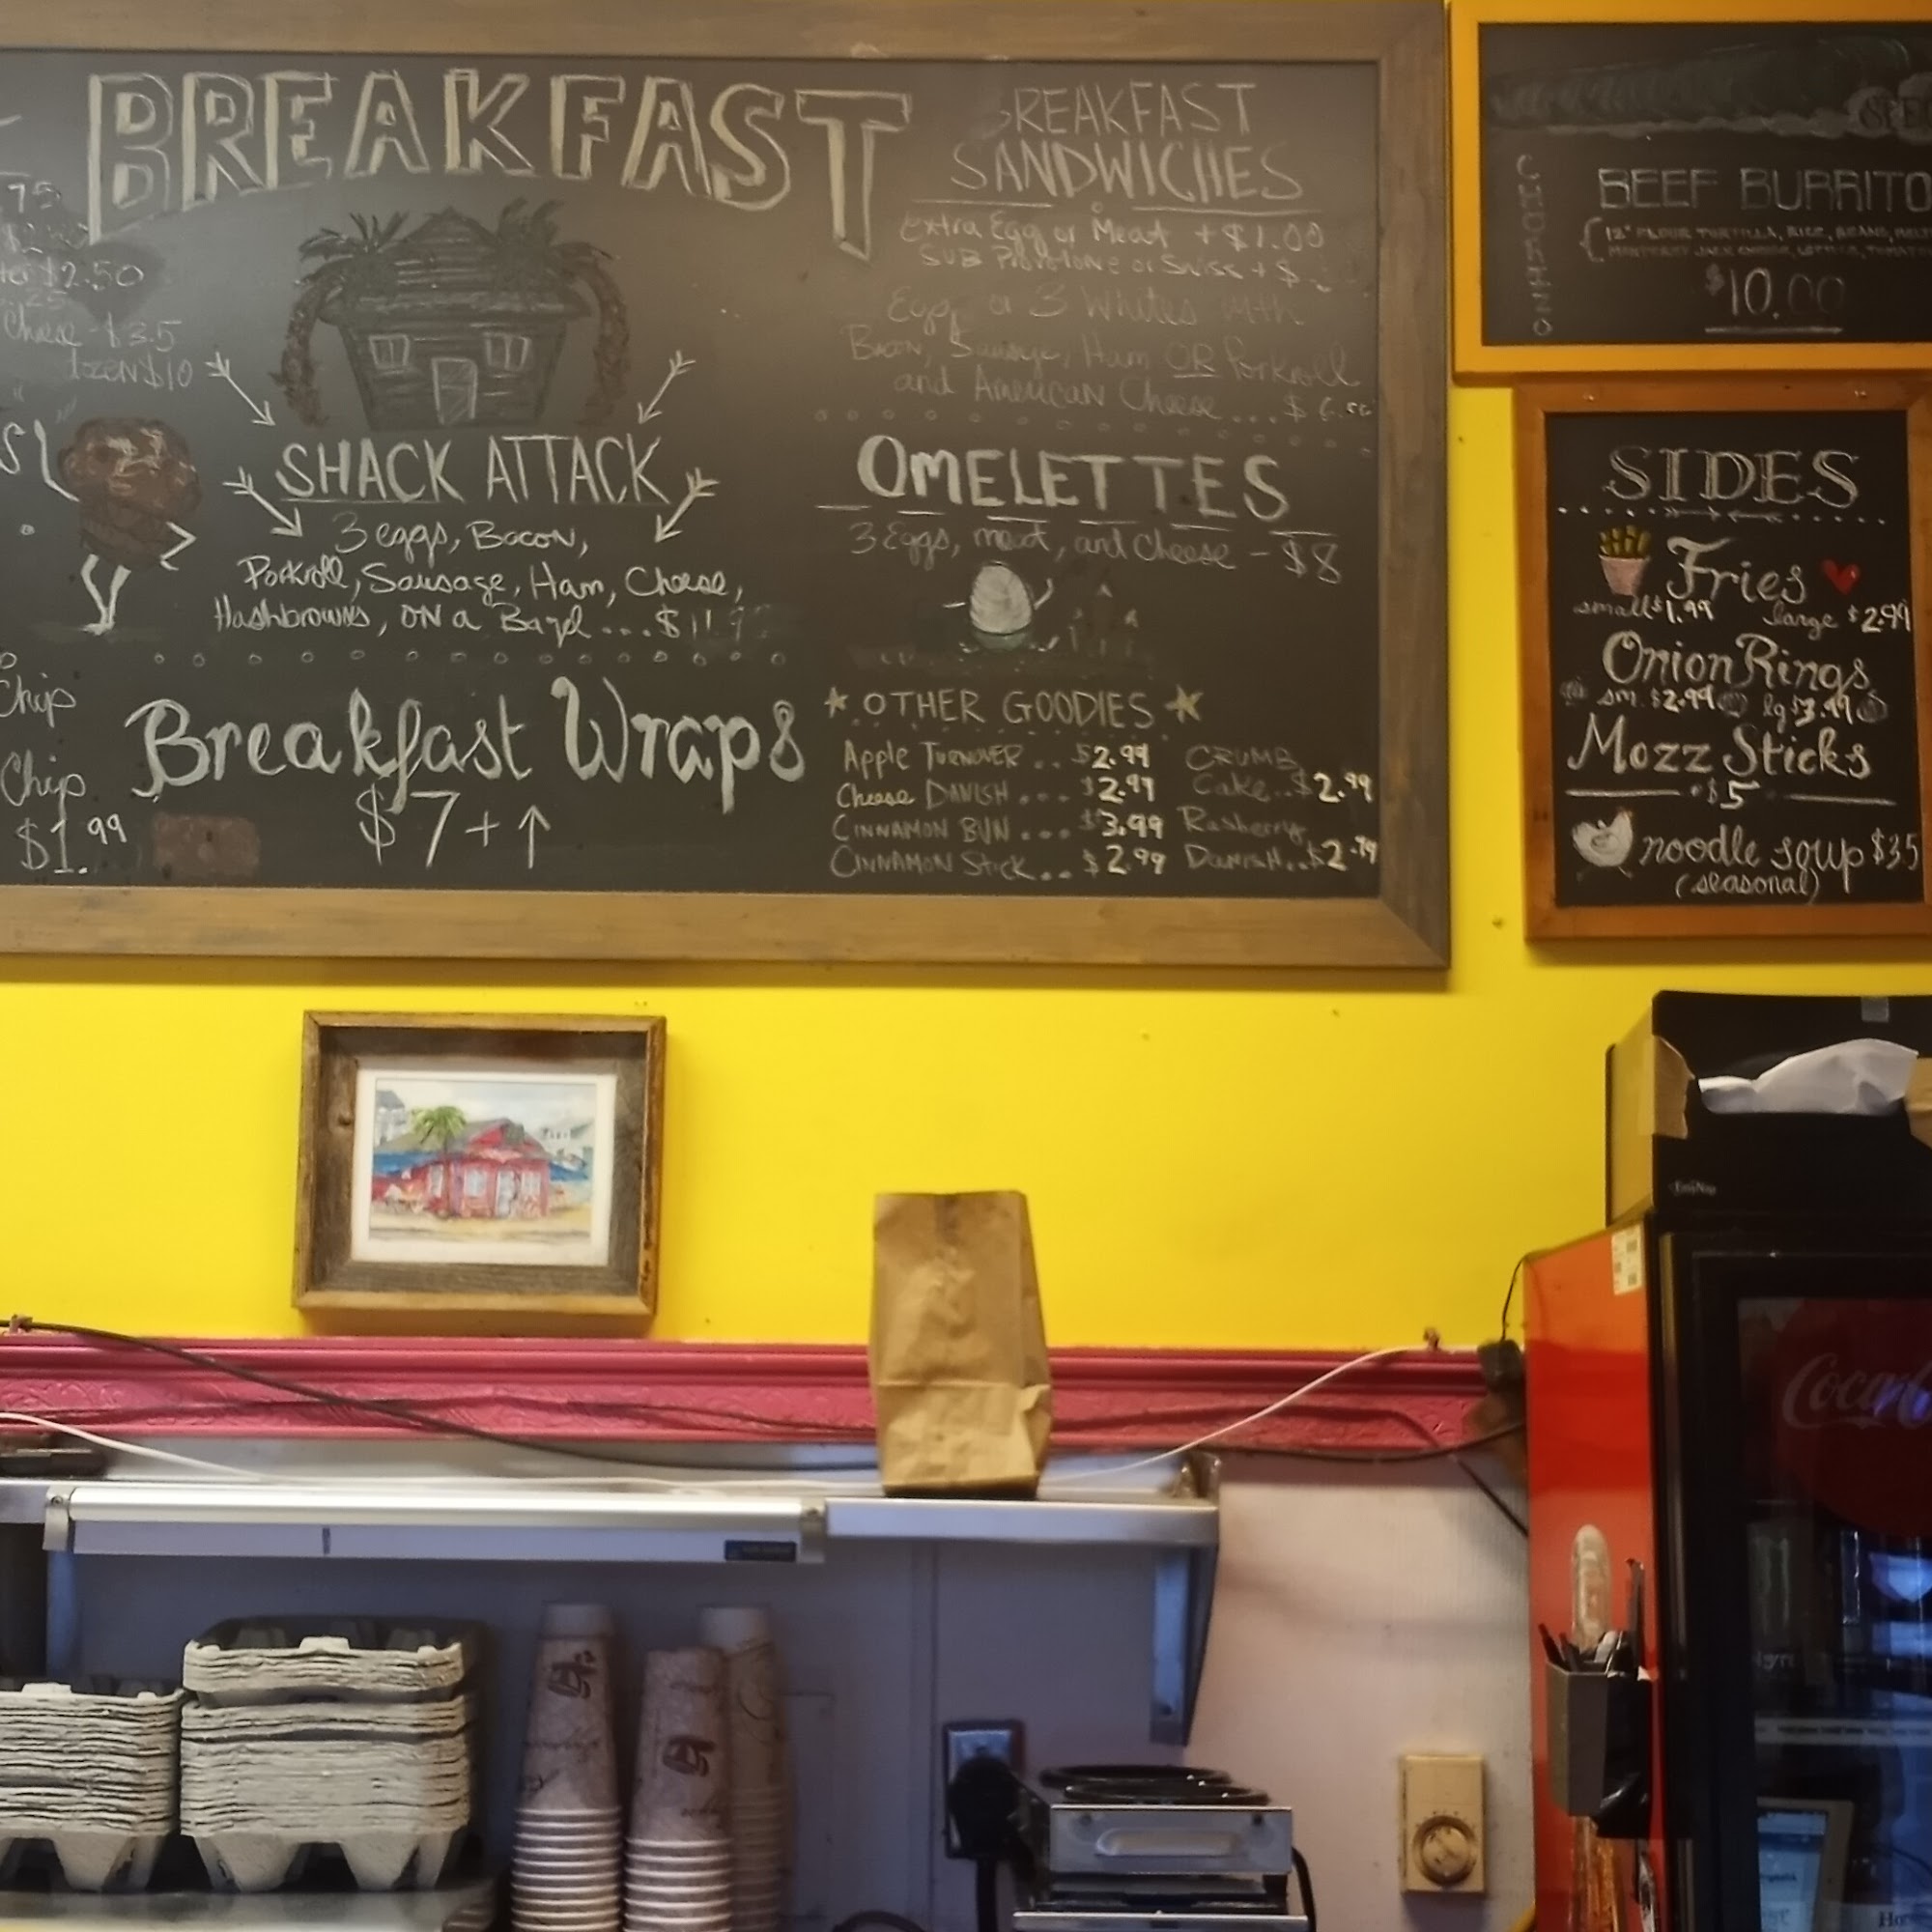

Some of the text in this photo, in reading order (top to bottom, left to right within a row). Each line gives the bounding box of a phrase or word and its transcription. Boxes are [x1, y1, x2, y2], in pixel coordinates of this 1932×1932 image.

[997, 80, 1256, 135] REAKFAST
[88, 68, 912, 261] BREAKFAST
[951, 140, 1304, 203] SANDWICHES
[1598, 167, 1932, 213] BEEF BURRITO
[900, 212, 983, 242] Extra
[990, 211, 1048, 256] Egg
[1092, 216, 1169, 248] Meat
[920, 243, 983, 269] SUB
[894, 364, 956, 395] and
[1166, 341, 1215, 372] OR
[276, 433, 671, 505] SHACK ATTACK
[856, 434, 1291, 523] OMELETTES
[1601, 446, 1860, 509] SIDES
[332, 510, 368, 554] 3
[376, 522, 461, 568] eggs,
[851, 523, 877, 554] 3
[1282, 538, 1343, 584] $8
[529, 560, 616, 608] Ham,
[1666, 536, 1807, 605] Fries
[1573, 595, 1912, 641] small $1.99 large $2.99
[1602, 629, 1871, 694] Onion Rings
[863, 688, 1154, 729] OTHER GOODIES
[1652, 685, 1715, 713] $2.99
[124, 675, 806, 814] Breakfast Wraps
[843, 739, 910, 781] Apple
[1072, 743, 1151, 770] $2.99
[1567, 712, 1872, 780] Mozz Sticks
[1, 749, 86, 806] Chip
[1080, 774, 1156, 804] $2.99
[1291, 770, 1374, 803] $2.99
[1706, 779, 1762, 810] $5
[16, 811, 128, 873] $1.99
[958, 815, 1010, 845] BUN
[1079, 809, 1164, 839] $3.99
[1082, 843, 1166, 876] $2.99
[1639, 823, 1761, 867] noodle
[1770, 836, 1864, 895] soup
[1674, 867, 1820, 905] (seasonal)
